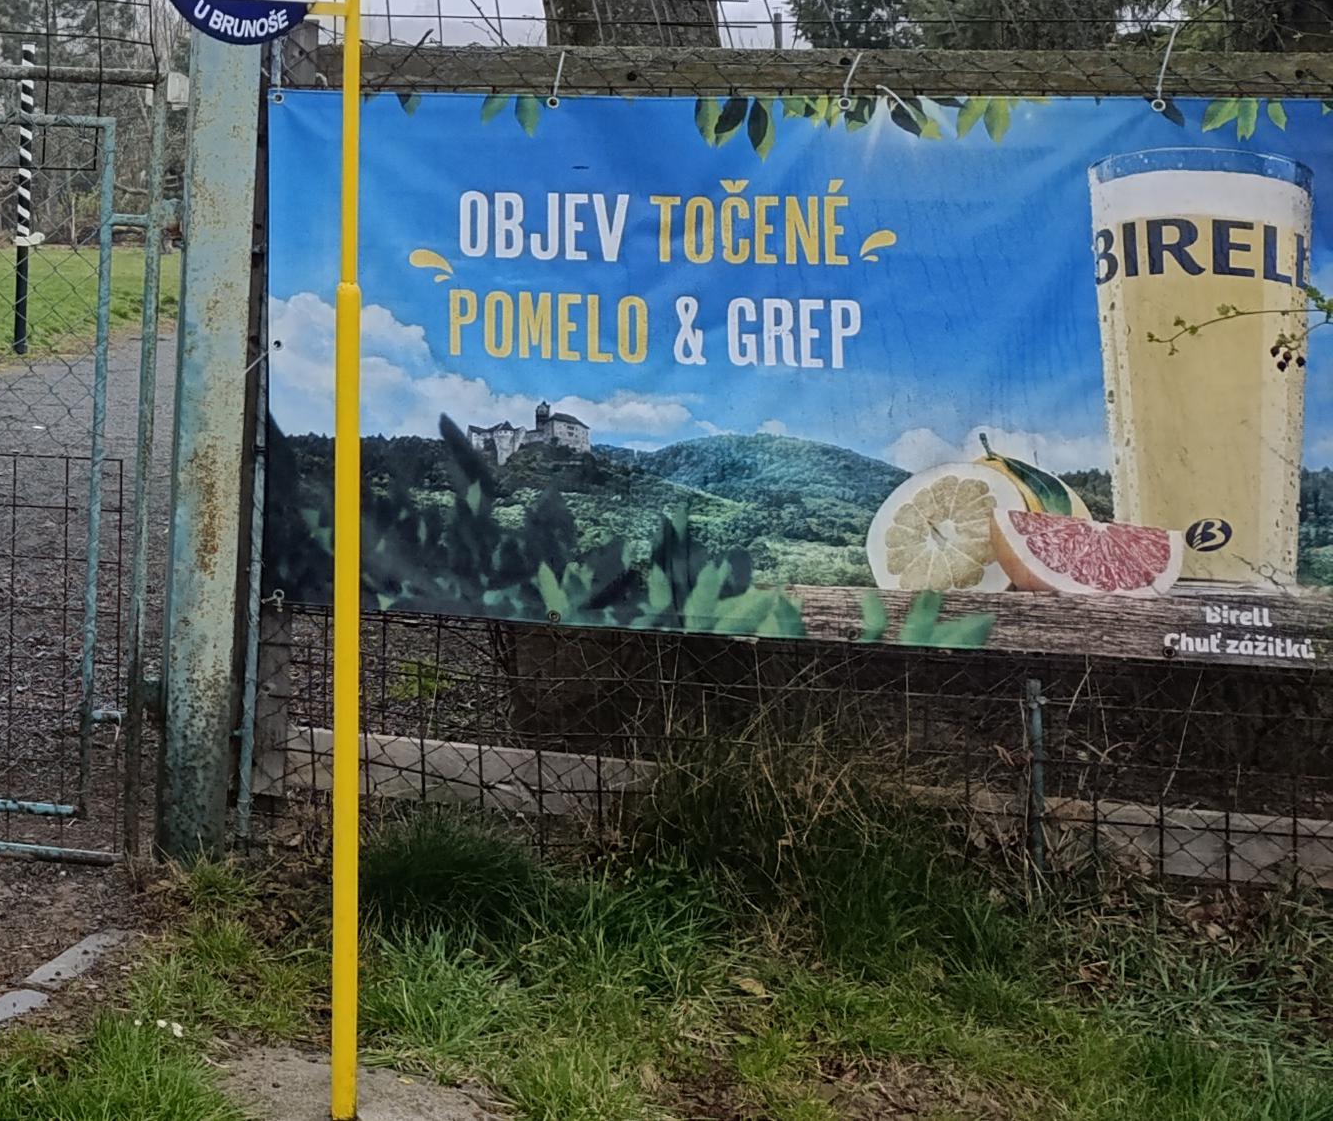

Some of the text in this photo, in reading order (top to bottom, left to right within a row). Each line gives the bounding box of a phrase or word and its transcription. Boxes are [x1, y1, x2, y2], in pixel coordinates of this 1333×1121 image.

[194, 0, 289, 38] U BRUNOŠE
[459, 179, 850, 265] OBJEV TOČENÉ
[448, 288, 862, 369] POMELO & GREP
[1203, 605, 1273, 628] Birell
[1163, 632, 1316, 660] Chuť zážitků
